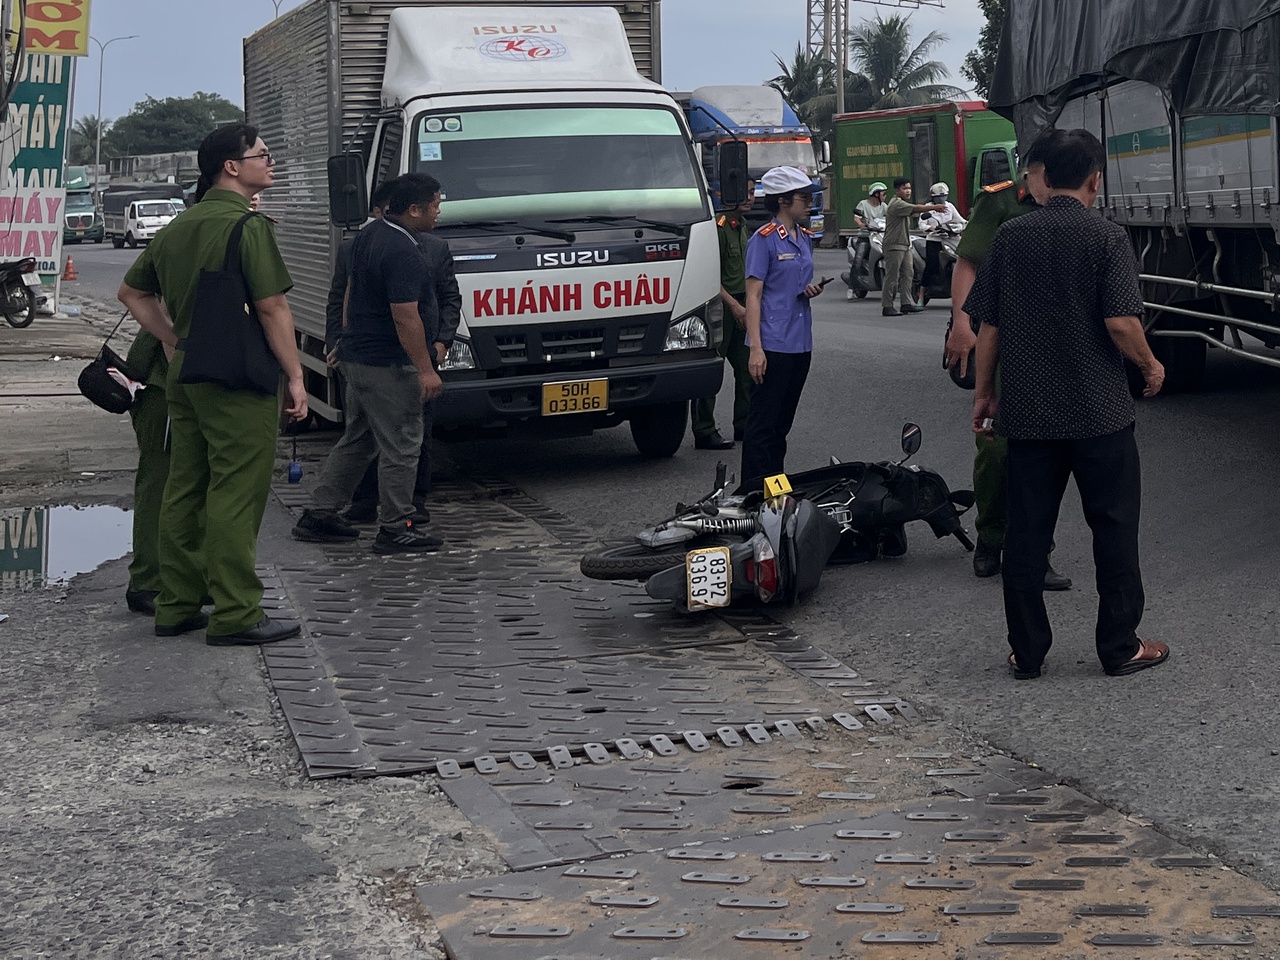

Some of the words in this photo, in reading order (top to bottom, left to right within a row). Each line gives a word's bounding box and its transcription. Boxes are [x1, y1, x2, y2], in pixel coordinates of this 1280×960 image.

[472, 25, 558, 36] ISUZU
[6, 94, 63, 149] MÁY
[0, 192, 62, 224] MÁY
[0, 230, 58, 258] MAY
[536, 249, 609, 267] ISUZU
[473, 279, 582, 318] KHÁNH
[593, 273, 671, 309] CHÂU
[562, 382, 589, 397] 50H
[549, 396, 600, 413] 033.66
[773, 478, 783, 491] 1
[691, 555, 709, 603] 936.9
